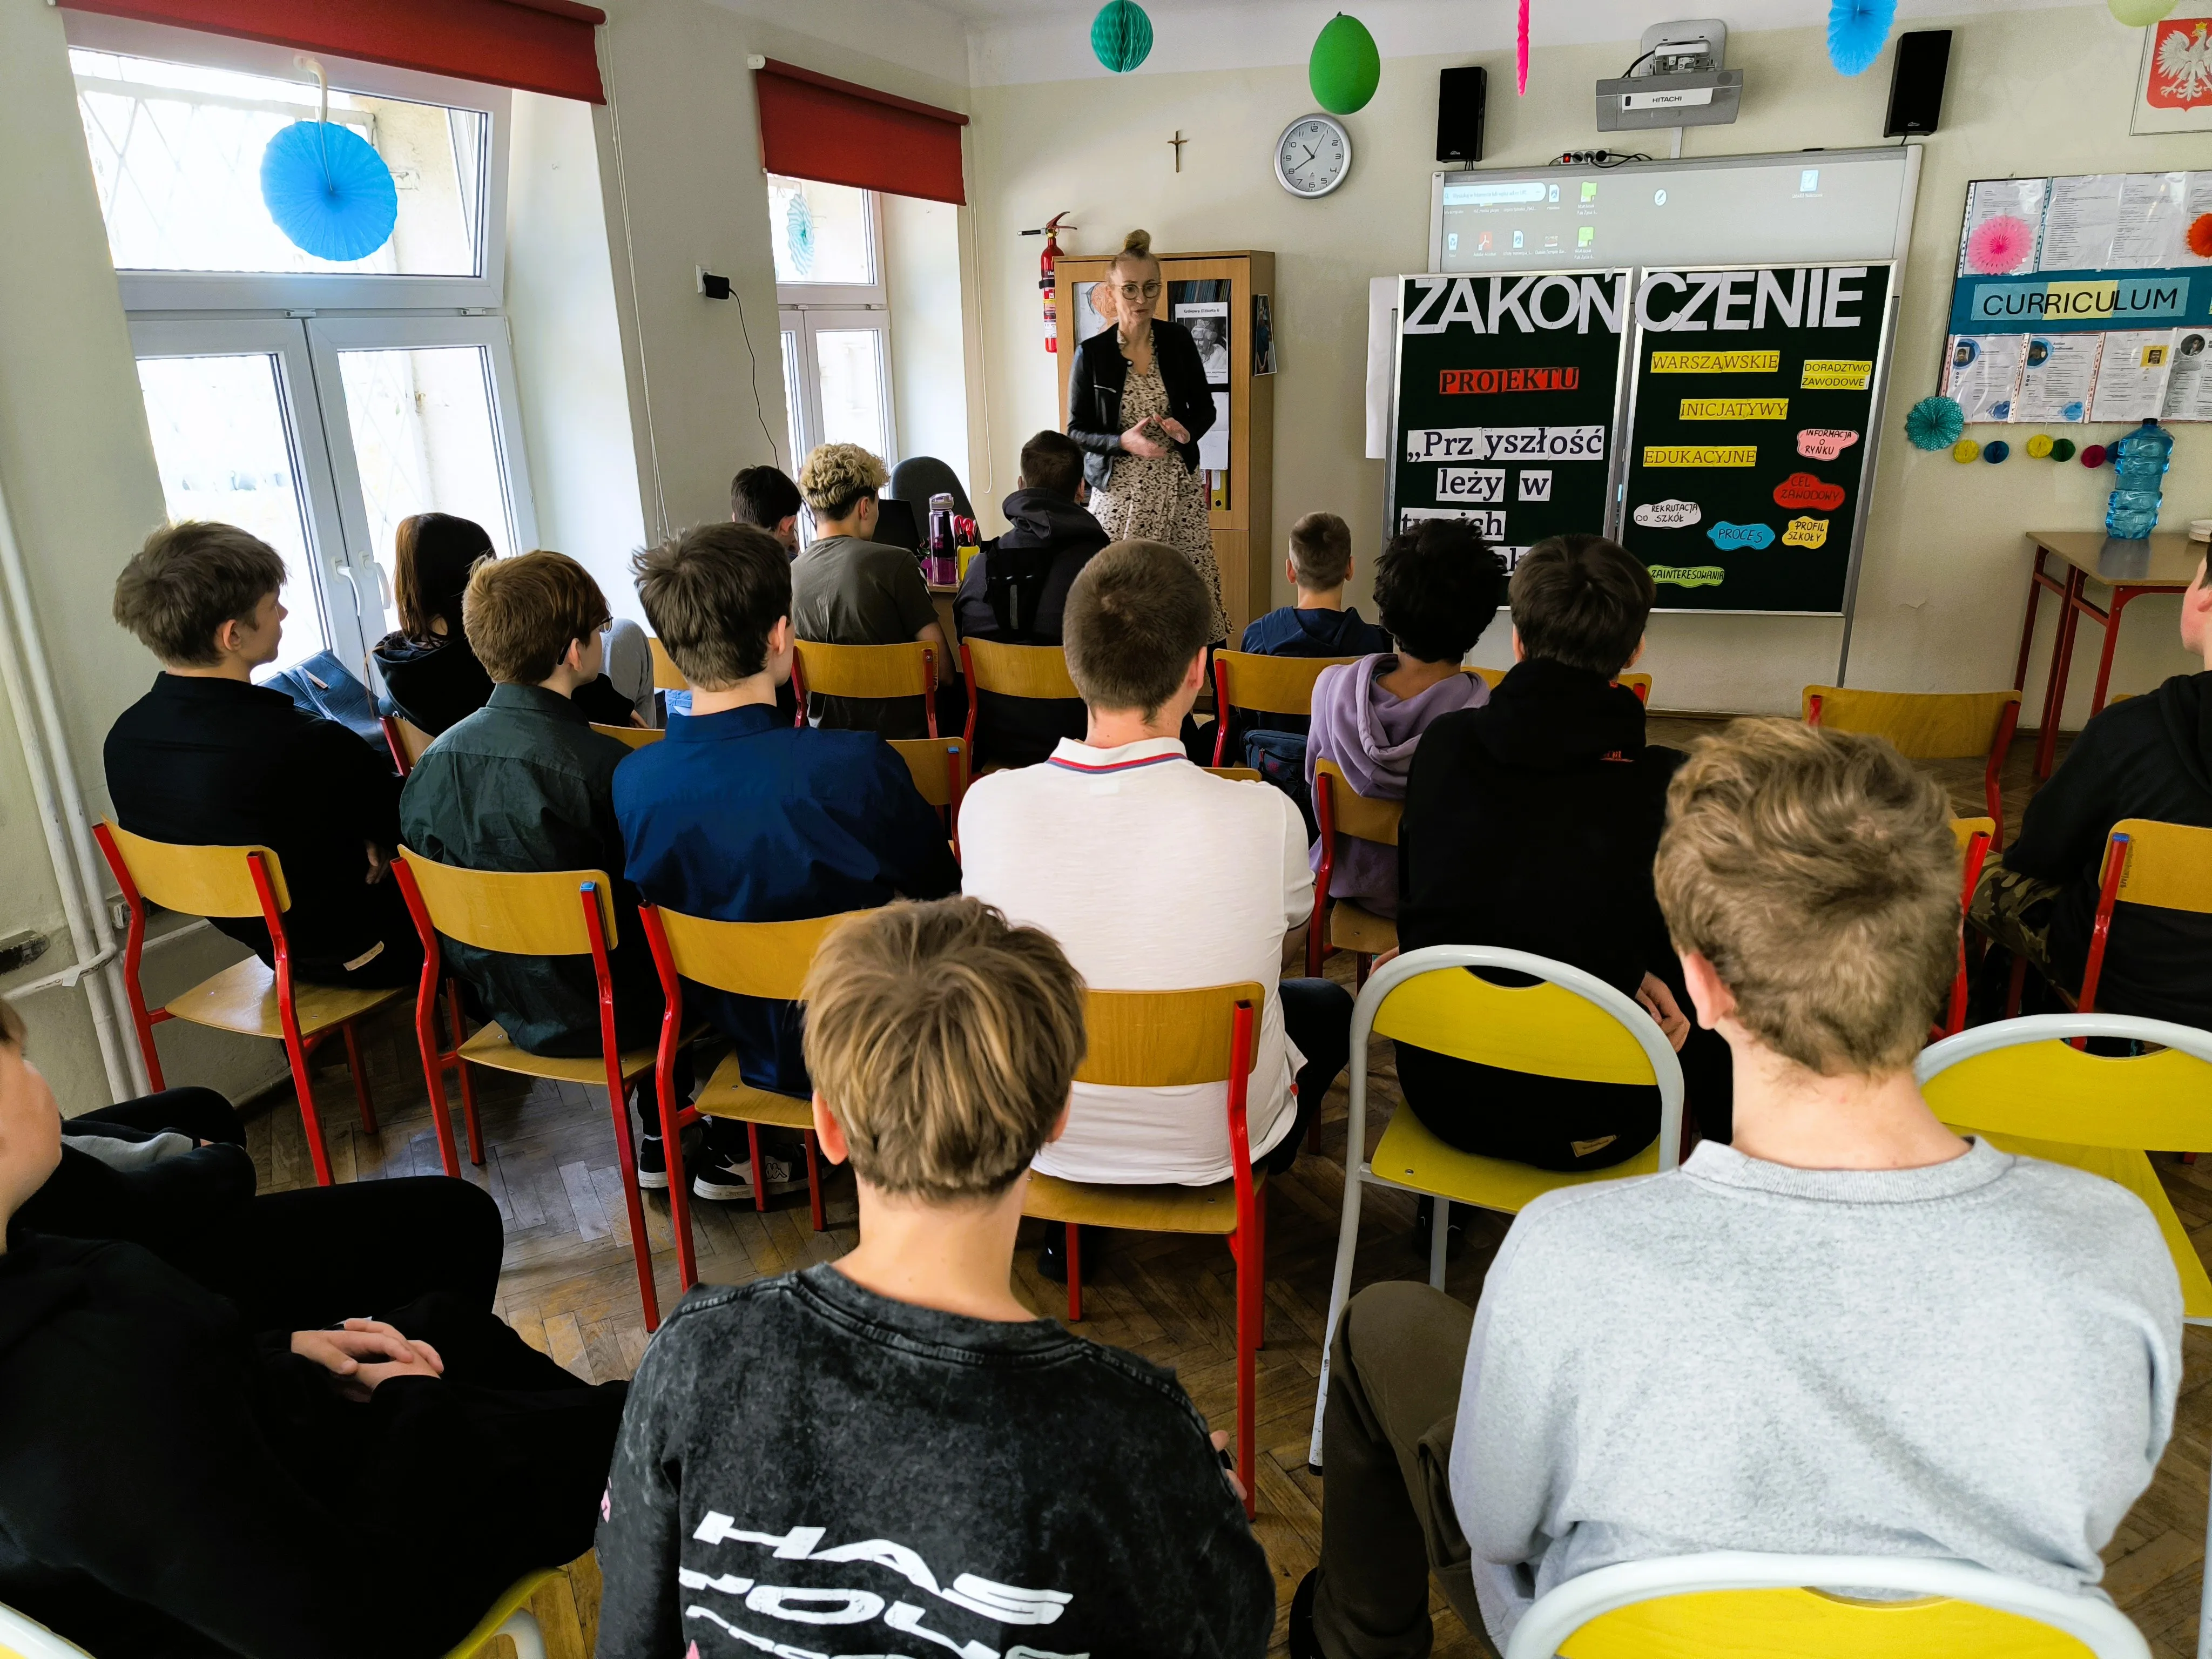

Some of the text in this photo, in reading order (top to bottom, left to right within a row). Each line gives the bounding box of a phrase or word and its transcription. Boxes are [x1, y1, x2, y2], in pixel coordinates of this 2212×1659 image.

[1297, 179, 1303, 187] 7
[1982, 288, 2177, 316] CURRICULUM
[1653, 355, 1779, 370] WARSZAWSKIE
[1804, 363, 1871, 373] DORADZTWO
[1441, 368, 1579, 393] PROJEKTU
[1802, 377, 1865, 387] ZAWODOWE
[1680, 402, 1789, 417] INICJATYWY
[1806, 429, 1852, 441] INFORMACJA
[1805, 445, 1835, 455] RYNKU
[1644, 450, 1756, 464] EDUKACYJNE
[1439, 469, 1549, 502] leży w
[1791, 476, 1810, 487] CEL
[1781, 489, 1840, 501] ZAWODOWY
[1651, 503, 1698, 514] REKRUTACJA
[1654, 511, 1684, 522] SZKÓŁ
[1795, 521, 1825, 532] PROFIL
[1718, 528, 1763, 543] PROCES
[1787, 531, 1822, 542] SZKOŁY
[1650, 569, 1724, 581] ZAINTERESOWANIA
